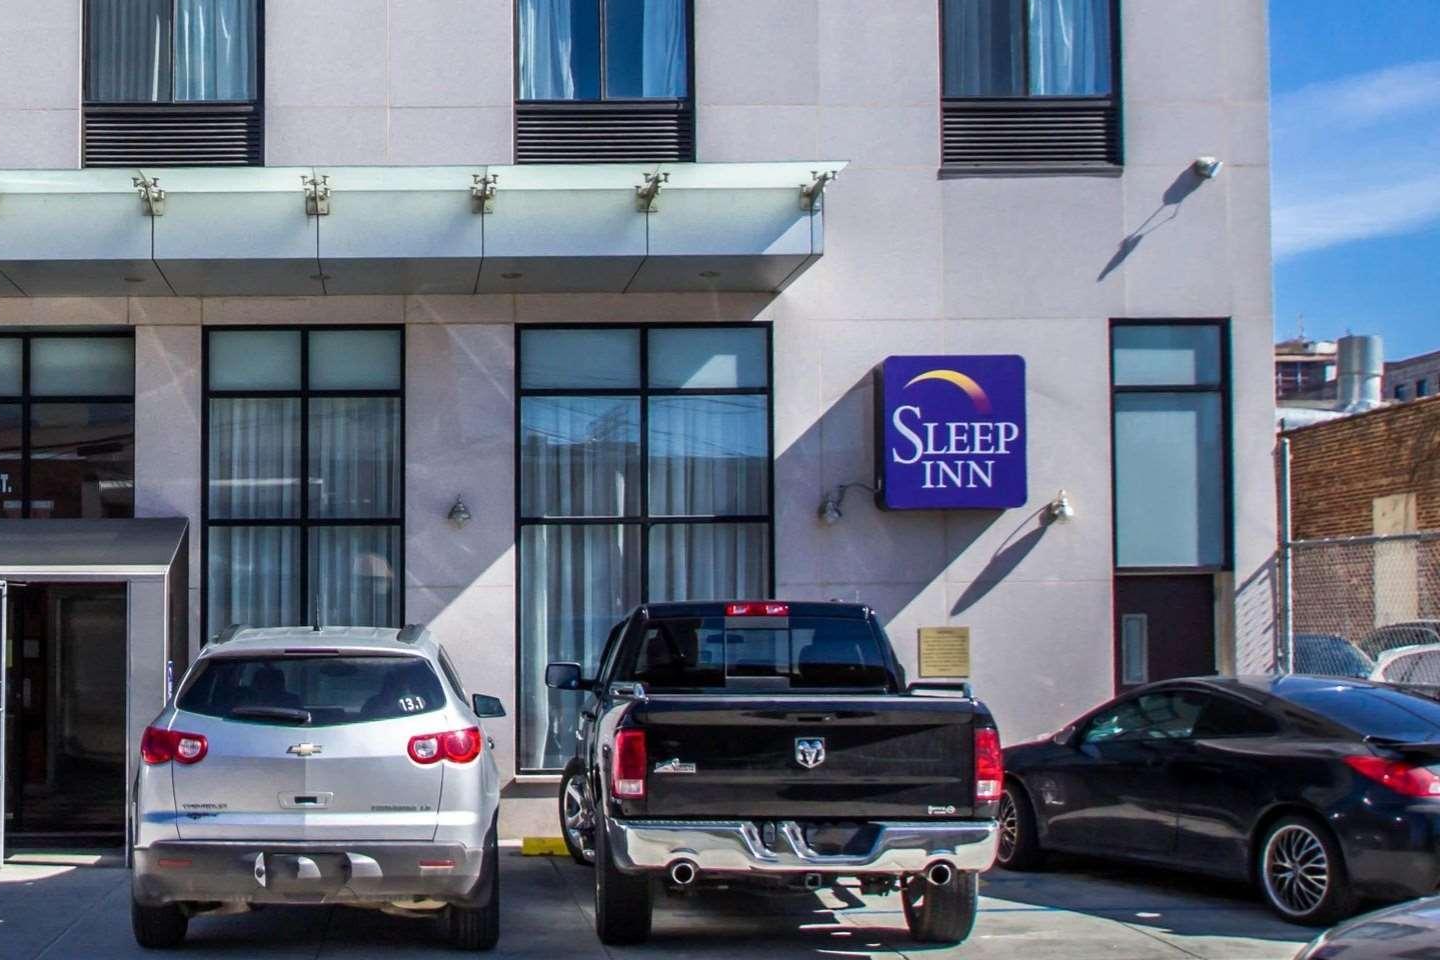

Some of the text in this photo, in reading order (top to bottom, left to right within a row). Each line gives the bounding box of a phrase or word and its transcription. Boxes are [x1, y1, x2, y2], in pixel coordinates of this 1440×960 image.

[892, 405, 1020, 464] SLEEP
[921, 460, 996, 488] INN
[398, 696, 424, 712] 13.1
